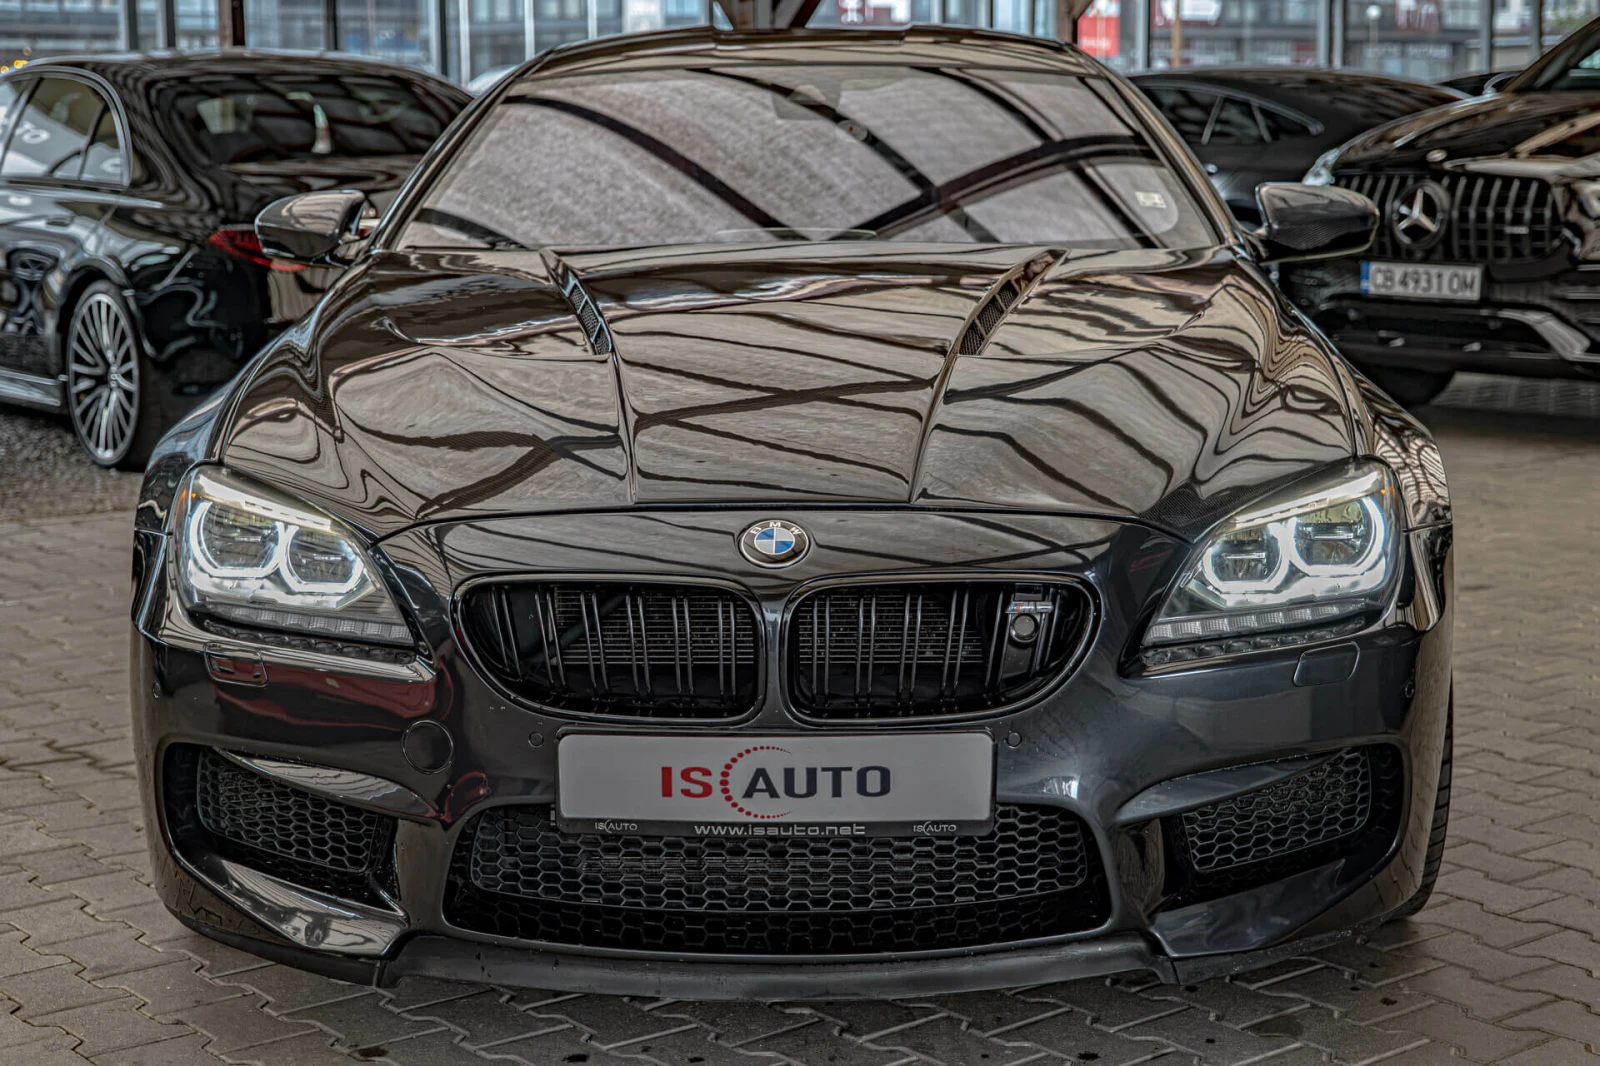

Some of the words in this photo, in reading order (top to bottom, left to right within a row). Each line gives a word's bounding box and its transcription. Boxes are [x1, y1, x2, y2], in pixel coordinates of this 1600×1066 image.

[750, 521, 801, 534] BMW
[661, 766, 713, 798] IS
[741, 766, 891, 798] AUTO
[694, 824, 866, 836] www.isauto.net
